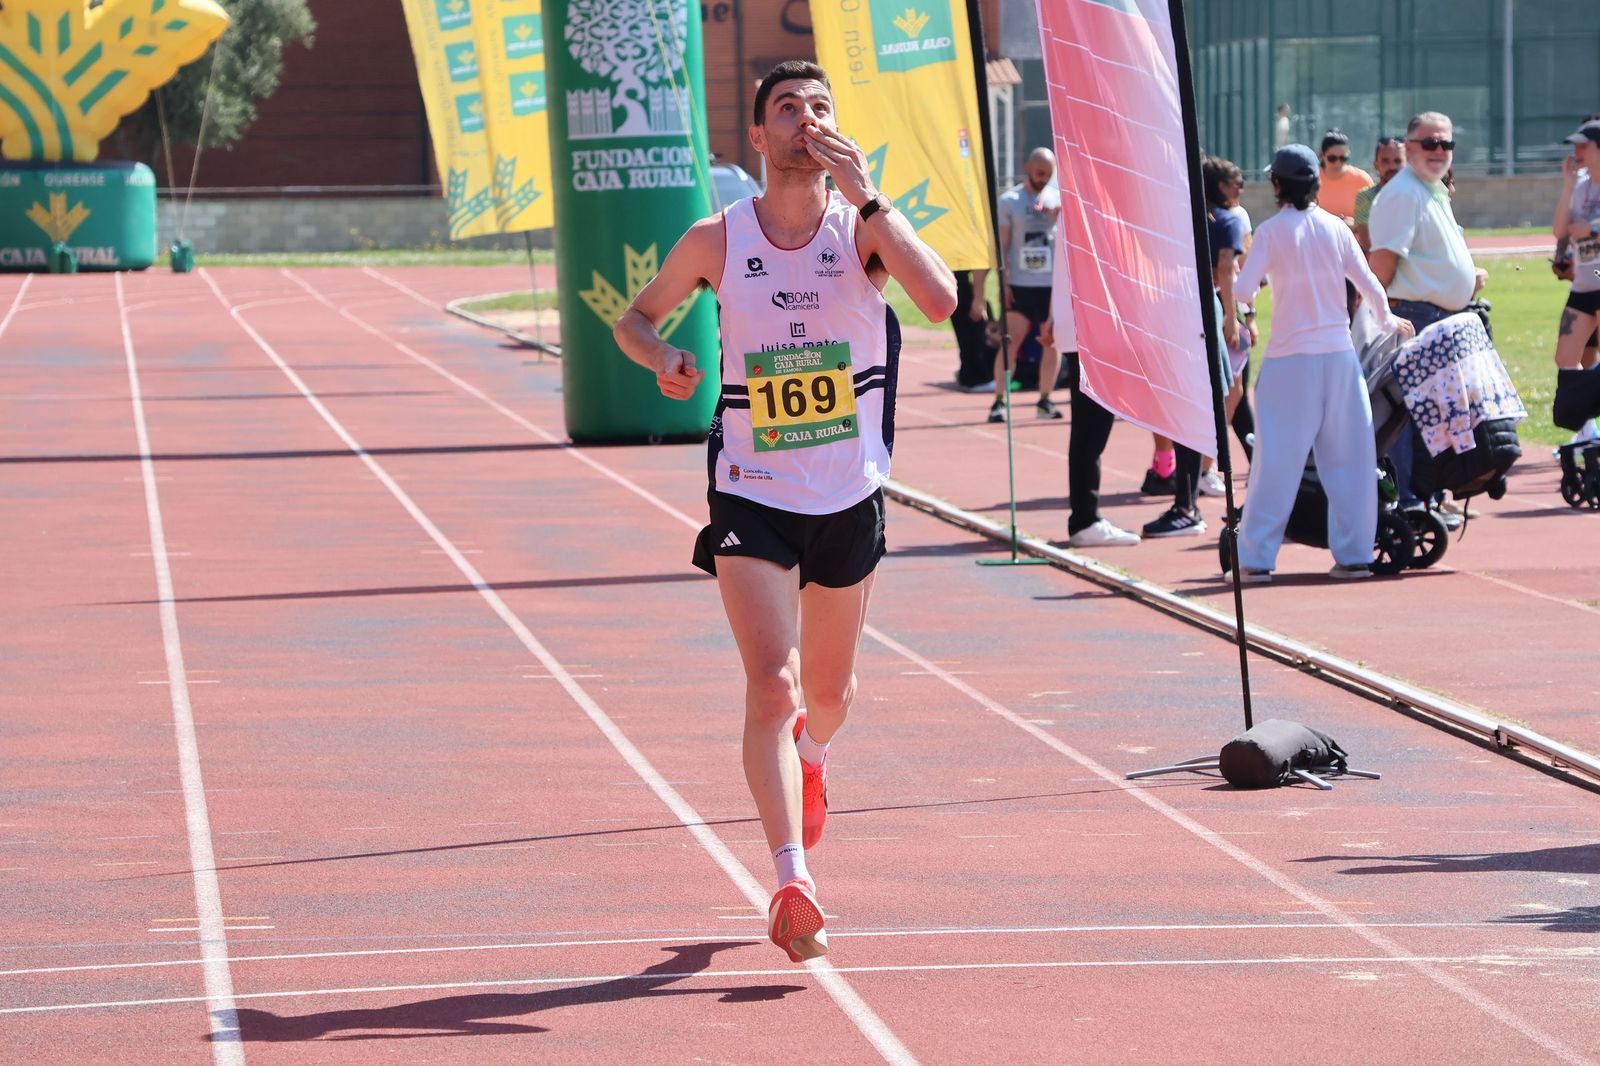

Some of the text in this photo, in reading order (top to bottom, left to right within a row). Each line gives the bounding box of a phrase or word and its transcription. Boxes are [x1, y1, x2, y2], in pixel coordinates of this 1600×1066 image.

[572, 147, 693, 170] FUNDACION
[44, 173, 105, 187] OURENSE
[573, 167, 696, 191] CAJA RURAL
[1, 247, 46, 264] CAJA
[786, 291, 819, 304] BOAN
[761, 342, 797, 353] luisa
[774, 358, 823, 370] CAJA RURAL
[757, 376, 837, 420] 169
[784, 430, 813, 442] CAJA
